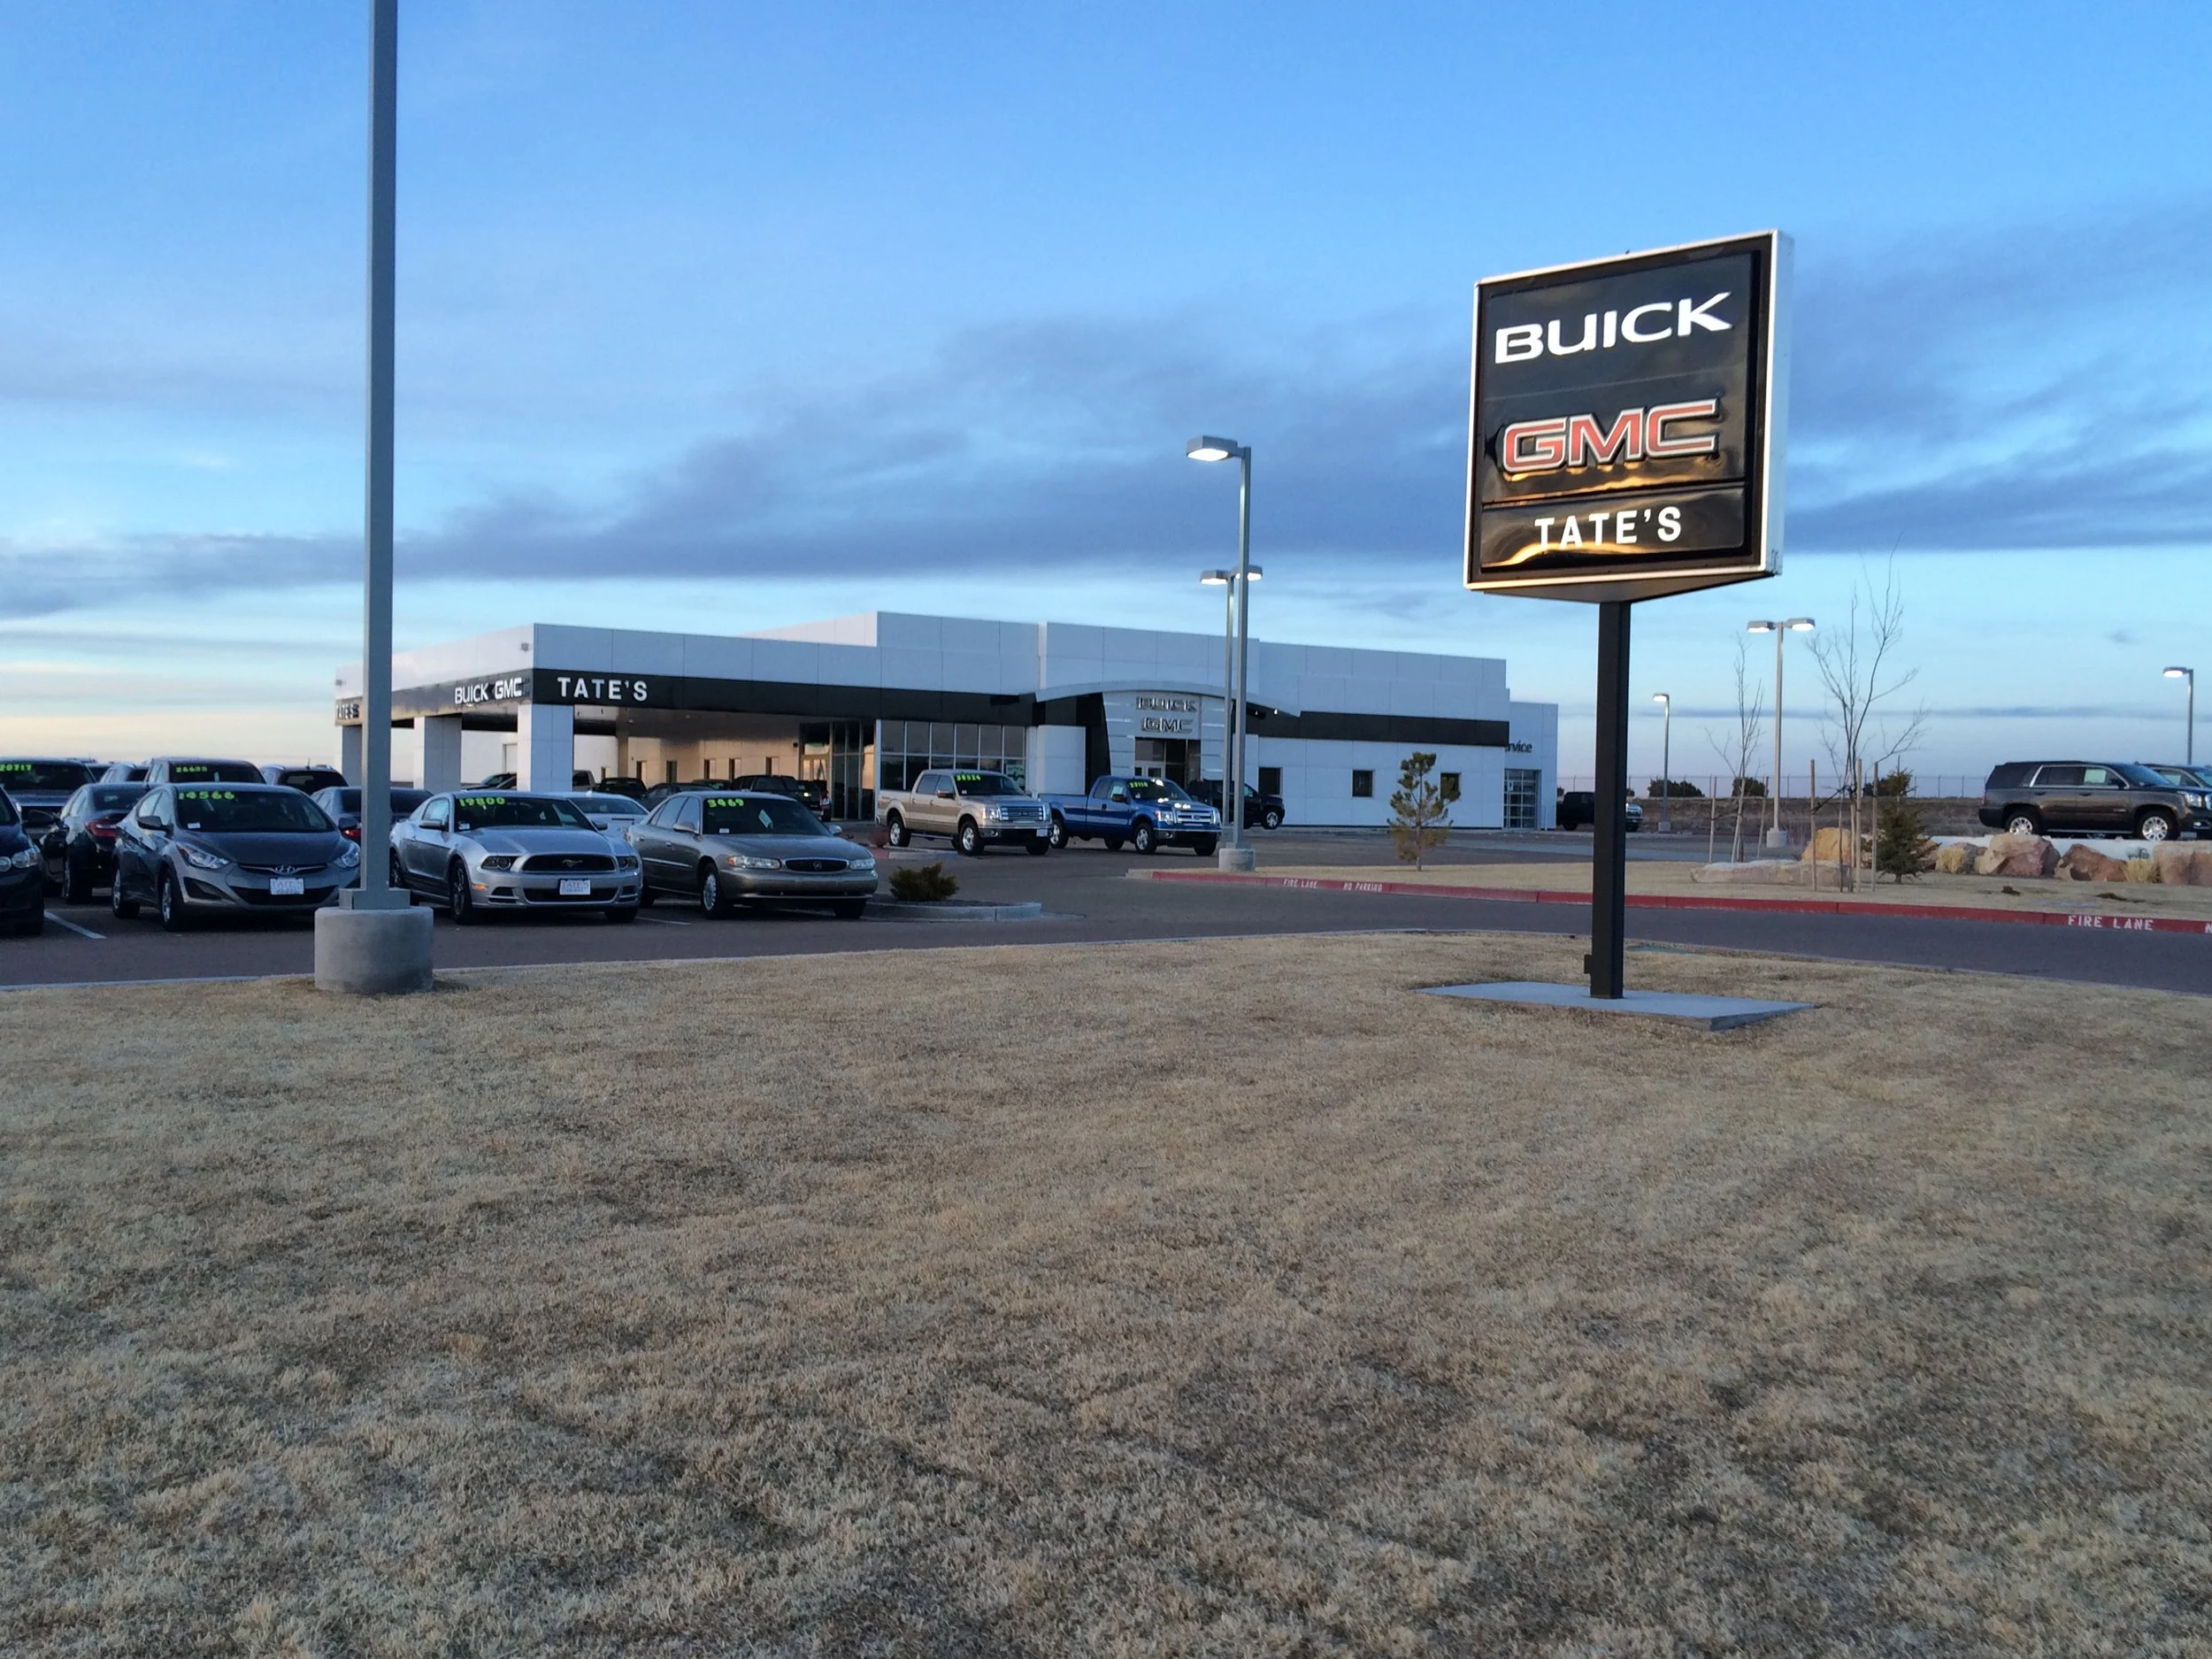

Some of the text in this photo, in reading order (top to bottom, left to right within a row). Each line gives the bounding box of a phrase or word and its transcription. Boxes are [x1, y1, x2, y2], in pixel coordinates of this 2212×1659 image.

[1495, 291, 1732, 364] BUICK
[1503, 398, 1719, 473] GMC
[1534, 506, 1681, 549] TATE'S
[455, 677, 522, 704] BUICK GMC
[557, 677, 648, 702] TATE'S
[1136, 697, 1197, 711] BUICK
[1141, 718, 1193, 733] GMC
[1505, 740, 1532, 753] rvice
[1283, 879, 1383, 893] FIRE LANE NO PARKING
[2068, 915, 2102, 928] FIRE
[2113, 918, 2154, 931] LANE
